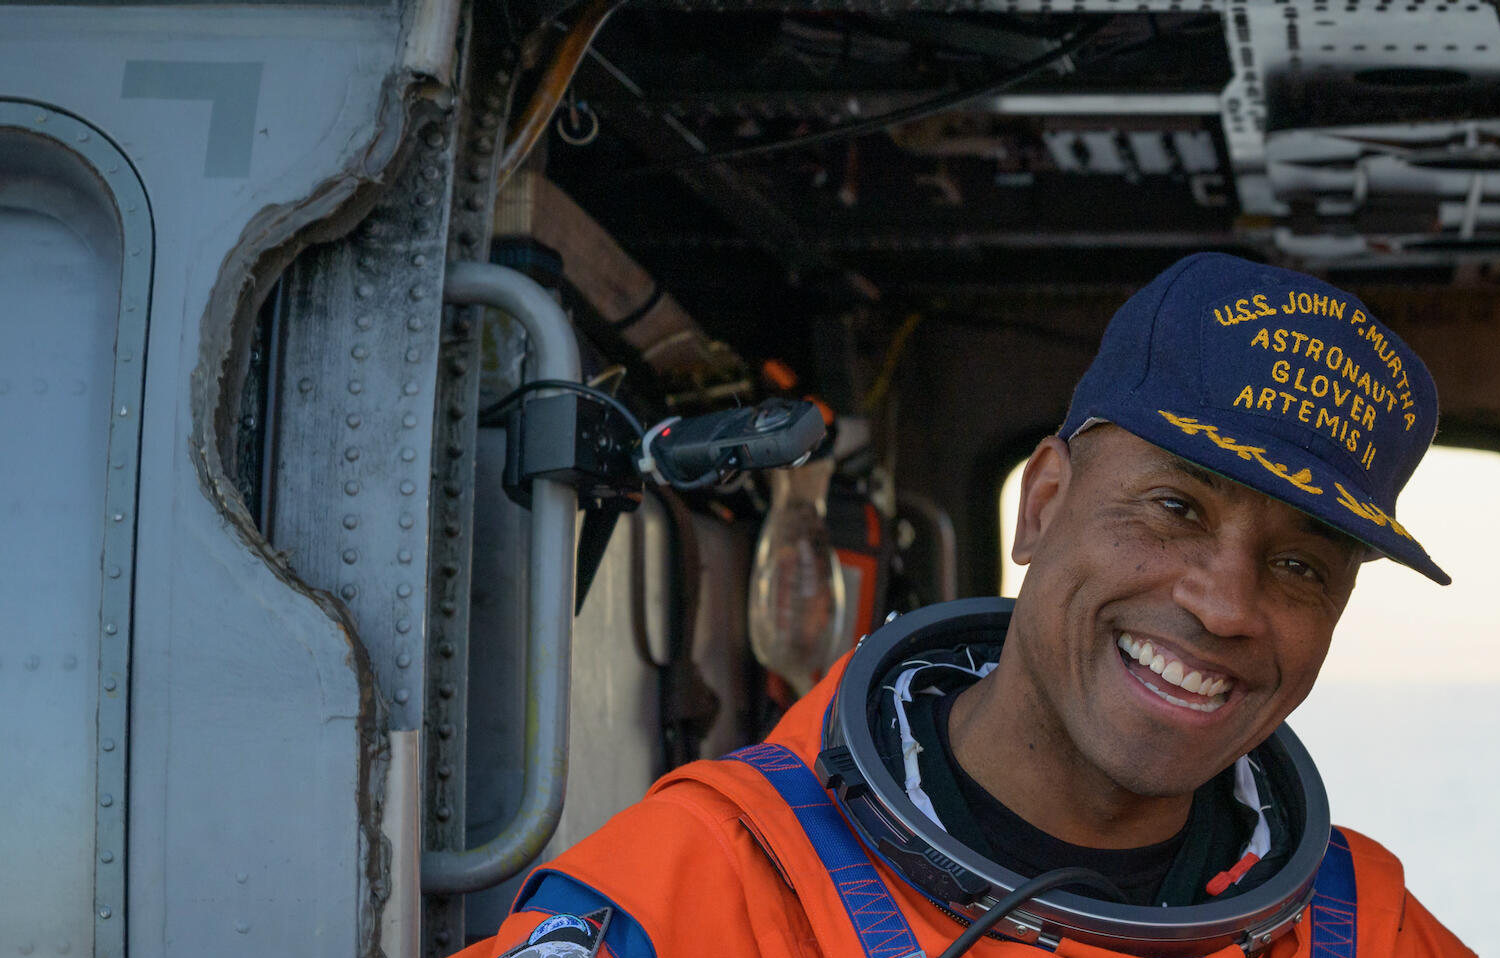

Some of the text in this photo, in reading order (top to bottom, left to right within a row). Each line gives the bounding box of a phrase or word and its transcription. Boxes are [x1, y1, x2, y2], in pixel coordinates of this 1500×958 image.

[1213, 294, 1278, 327] U.S.S.
[1281, 290, 1348, 321] JOHN
[1250, 327, 1398, 414] ASTRONAUT
[1271, 360, 1377, 431] GLOVER
[1233, 385, 1361, 452] ARTEMIS
